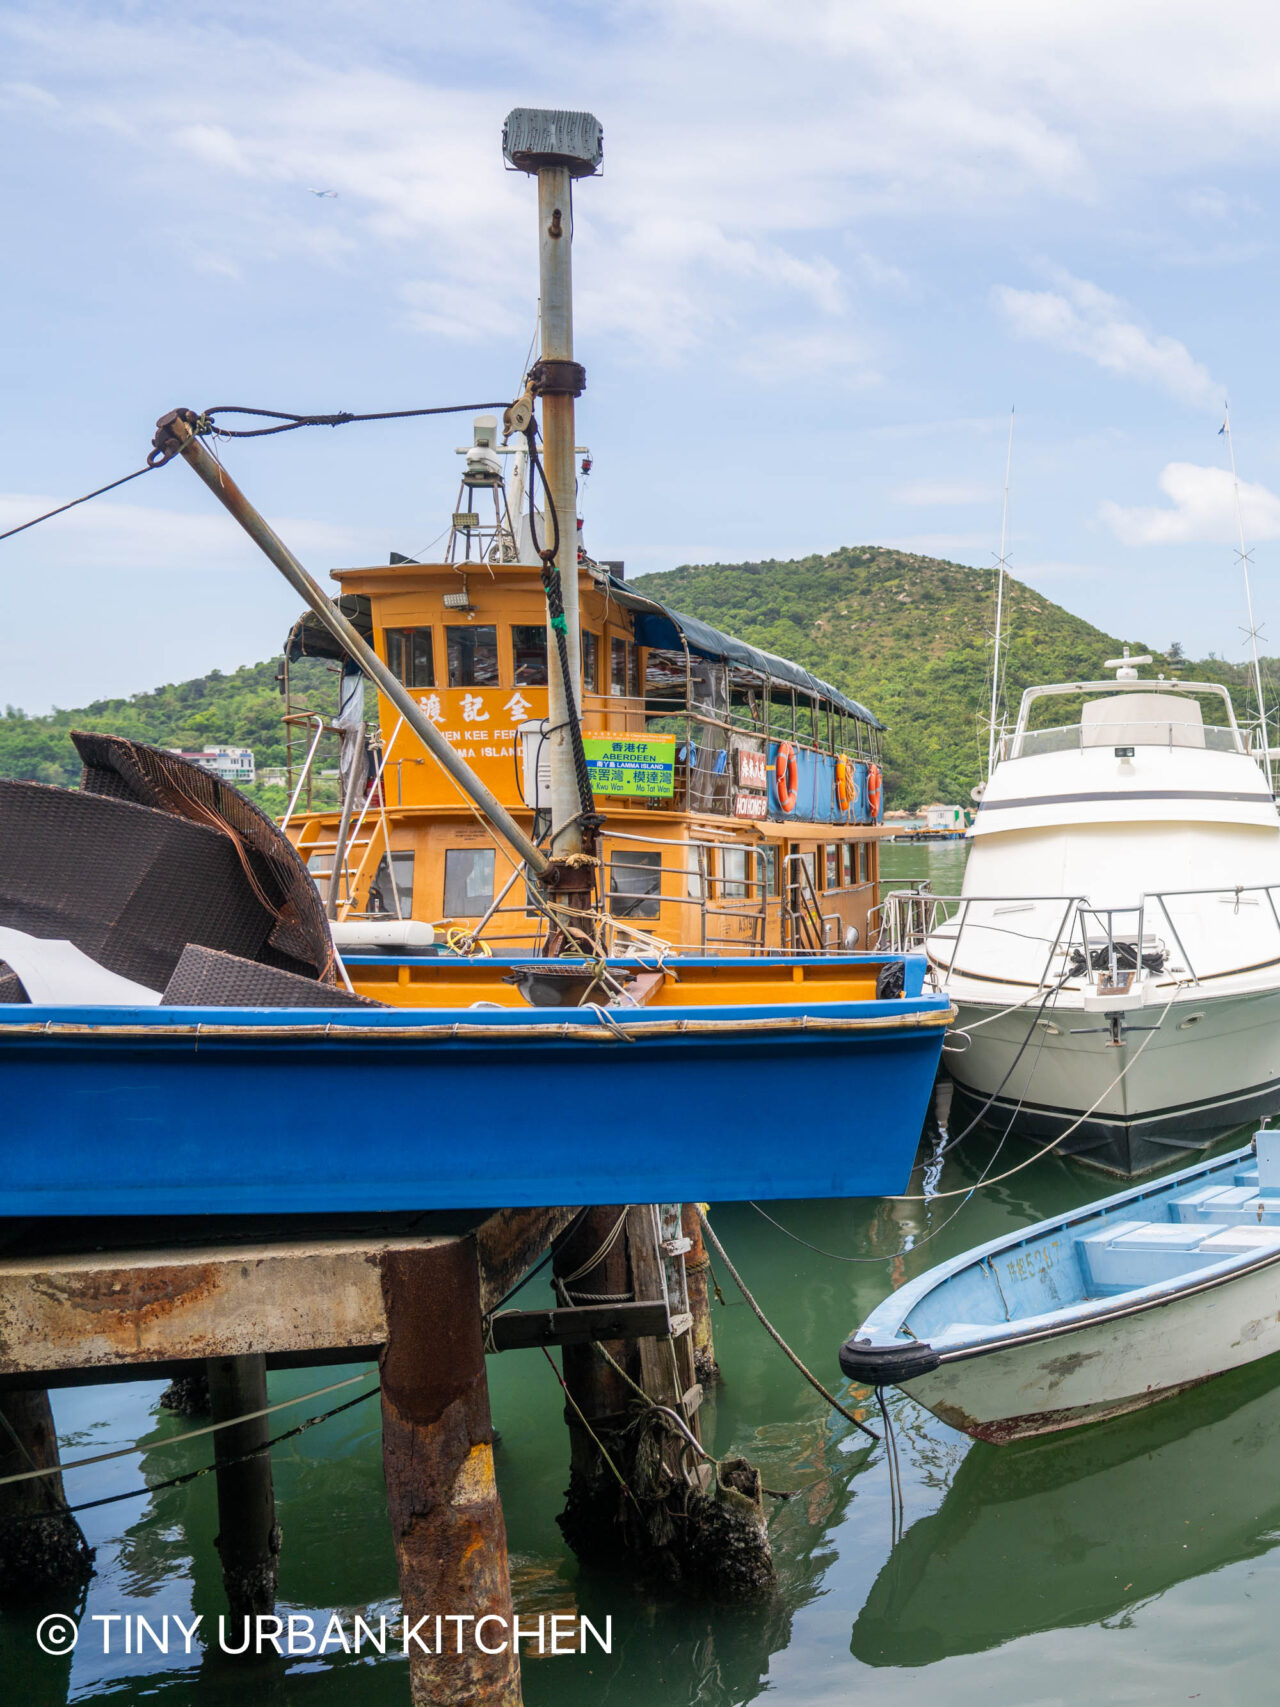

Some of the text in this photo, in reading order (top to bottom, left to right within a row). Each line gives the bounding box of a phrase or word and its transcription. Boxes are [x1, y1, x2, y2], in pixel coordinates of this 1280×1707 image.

[464, 730, 489, 740] KEE
[611, 742, 648, 754] 香港仔
[602, 753, 656, 762] ABERDEEN
[596, 782, 609, 791] Kwu
[611, 782, 624, 791] Wan
[657, 785, 671, 793] Wan
